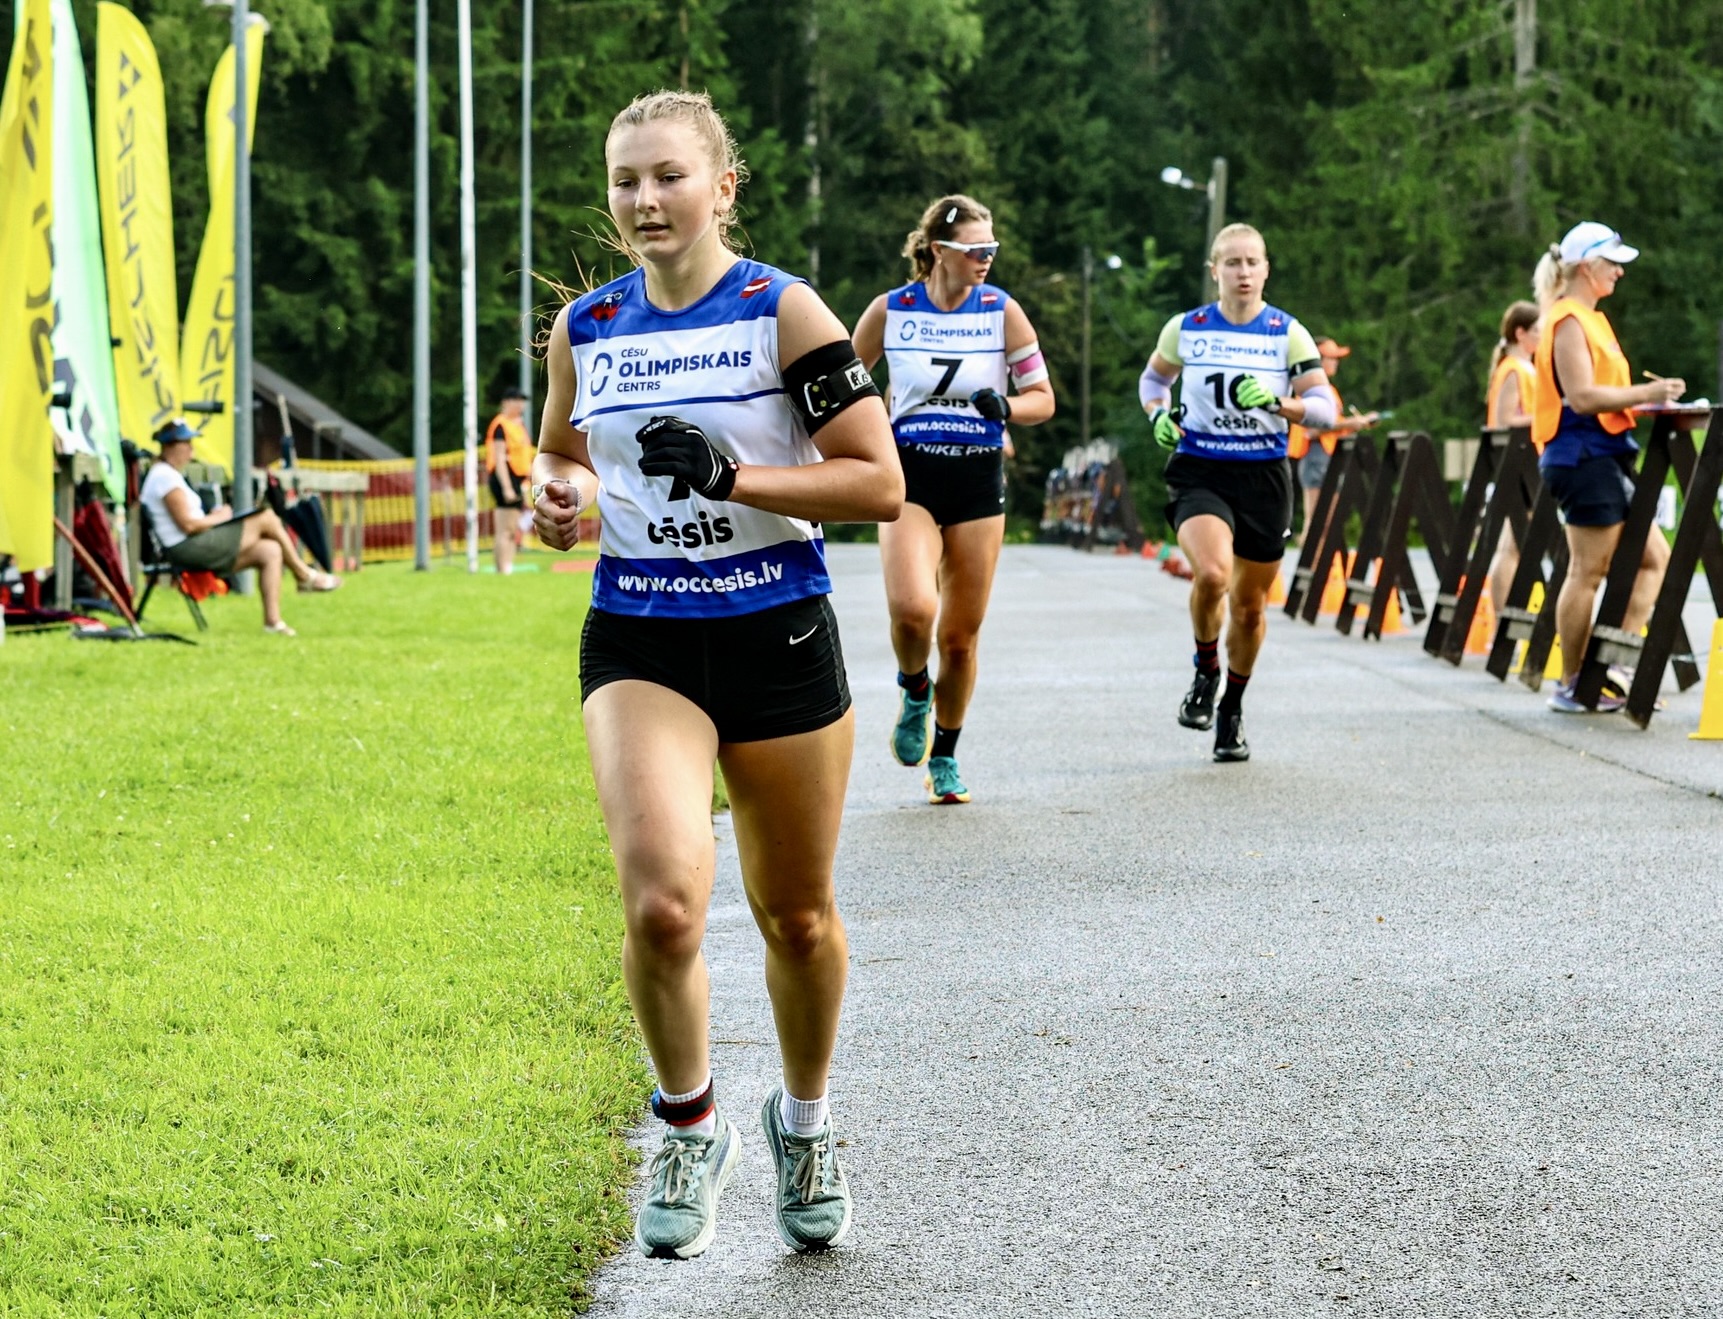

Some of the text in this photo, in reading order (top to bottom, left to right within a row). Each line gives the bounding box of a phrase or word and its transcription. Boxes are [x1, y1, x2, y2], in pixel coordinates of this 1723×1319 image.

[920, 327, 992, 337] OLIMPISKAIS
[621, 347, 648, 358] CĒSU
[1211, 345, 1277, 357] OLIMPISKAIS
[618, 351, 752, 378] OLIMPISKAIS
[931, 357, 964, 396] 7
[616, 380, 661, 393] CENTRS
[916, 443, 962, 456] NIKE
[647, 511, 734, 549] cēsis
[618, 561, 783, 593] www.occesis.lv
